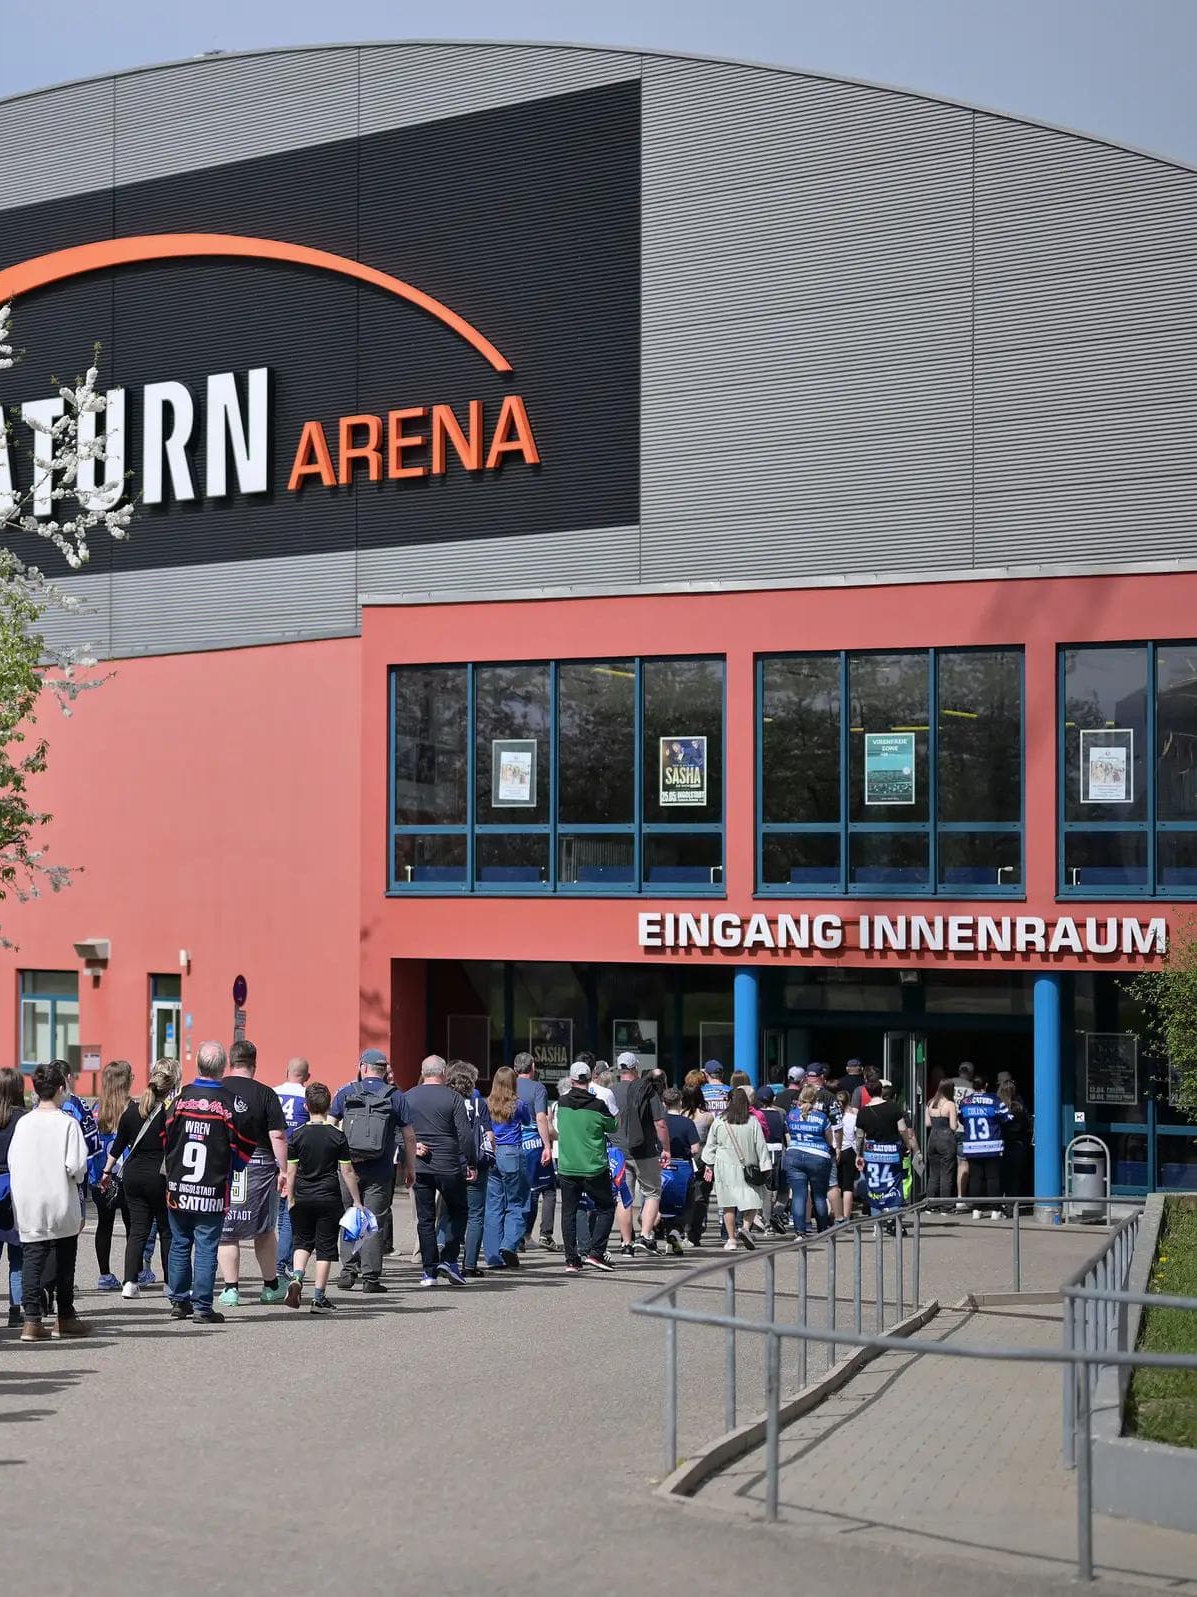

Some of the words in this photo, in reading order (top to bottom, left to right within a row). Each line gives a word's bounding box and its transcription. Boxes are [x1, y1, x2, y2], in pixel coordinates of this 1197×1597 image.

[287, 394, 541, 491] ARENA
[665, 766, 701, 785] SASHA
[638, 912, 842, 949] EINGANG
[859, 914, 1167, 954] INNENRAUM
[534, 1046, 568, 1063] SASHA
[185, 1120, 211, 1136] WREN
[968, 1117, 990, 1140] 13
[181, 1141, 208, 1183] 9
[867, 1163, 895, 1188] 34
[179, 1183, 216, 1196] INGOLSTADT
[178, 1194, 224, 1213] SATURN
[224, 1209, 252, 1221] STADT
